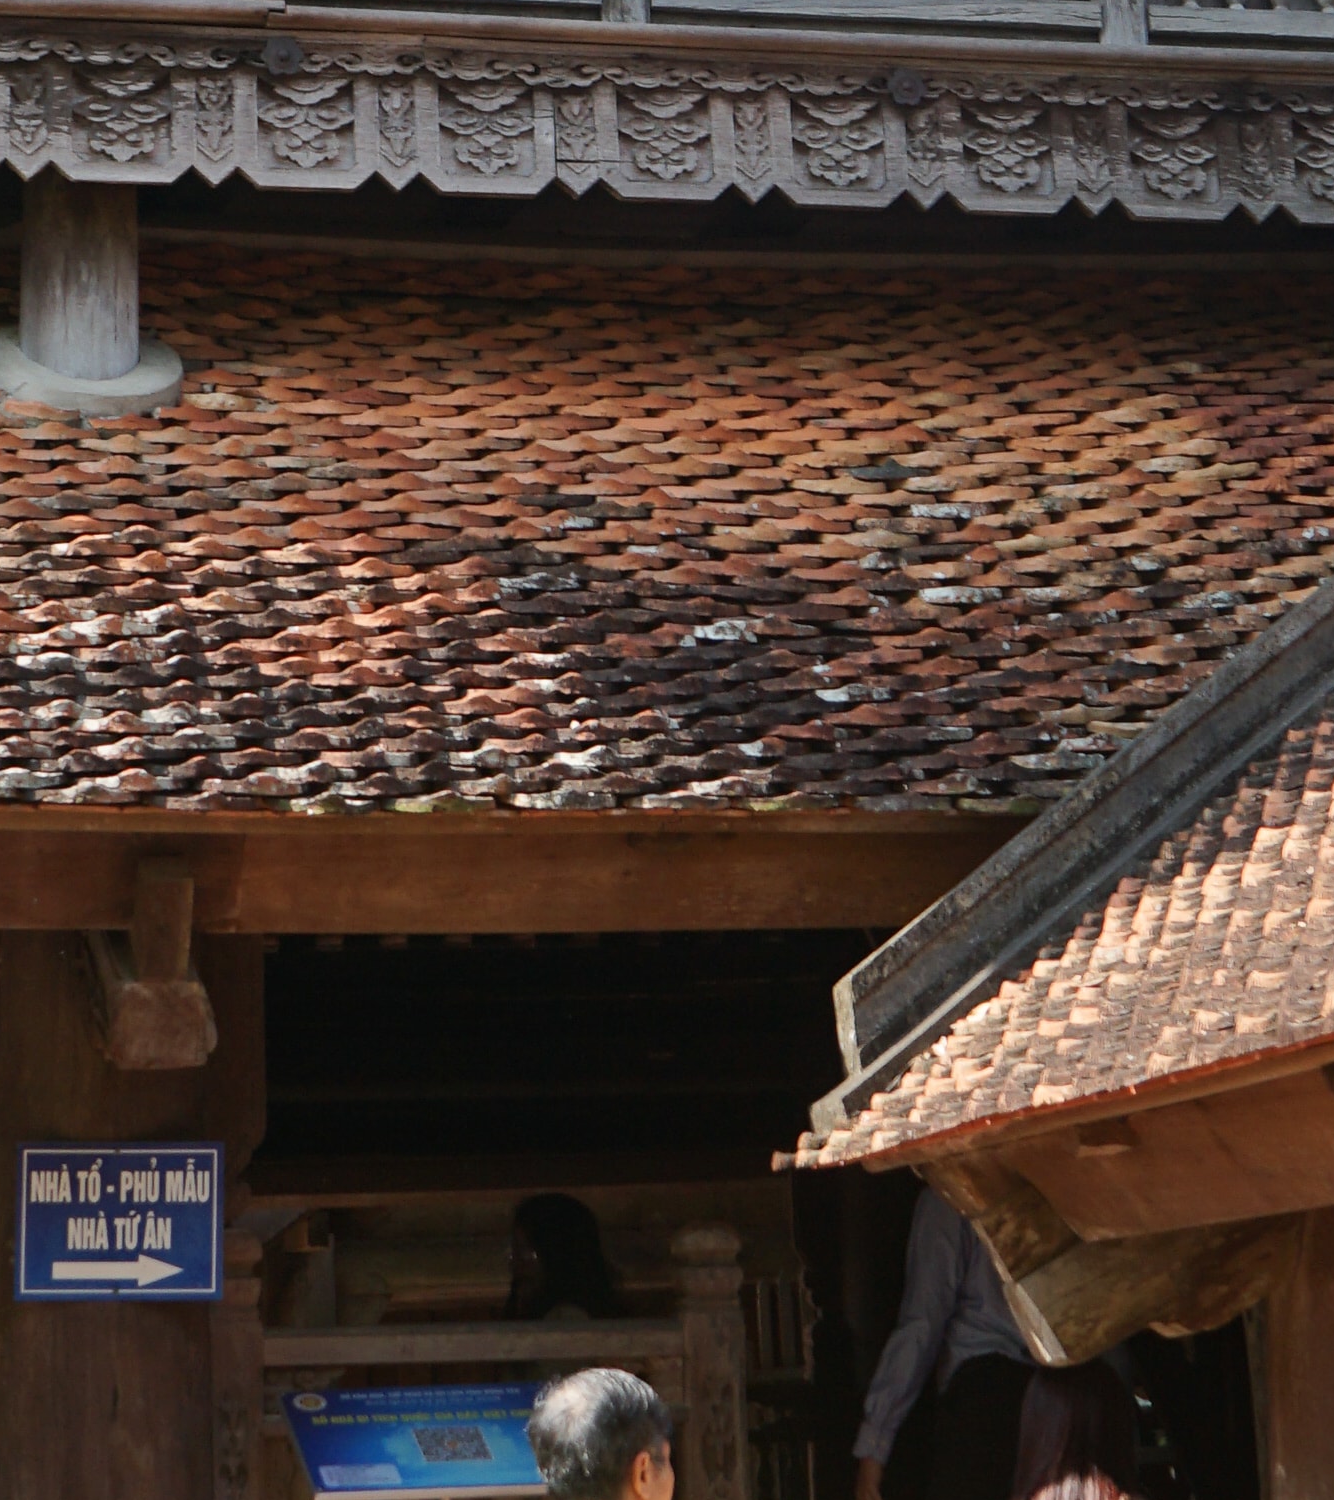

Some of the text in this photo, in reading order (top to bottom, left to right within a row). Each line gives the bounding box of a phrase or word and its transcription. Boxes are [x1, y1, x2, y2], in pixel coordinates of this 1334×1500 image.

[30, 1164, 71, 1203] NHÀ
[77, 1158, 102, 1203] TỔ
[120, 1157, 160, 1203] PHỦ
[165, 1158, 210, 1203] MẪU
[67, 1210, 172, 1249] NHÀ TỨ ÂN
